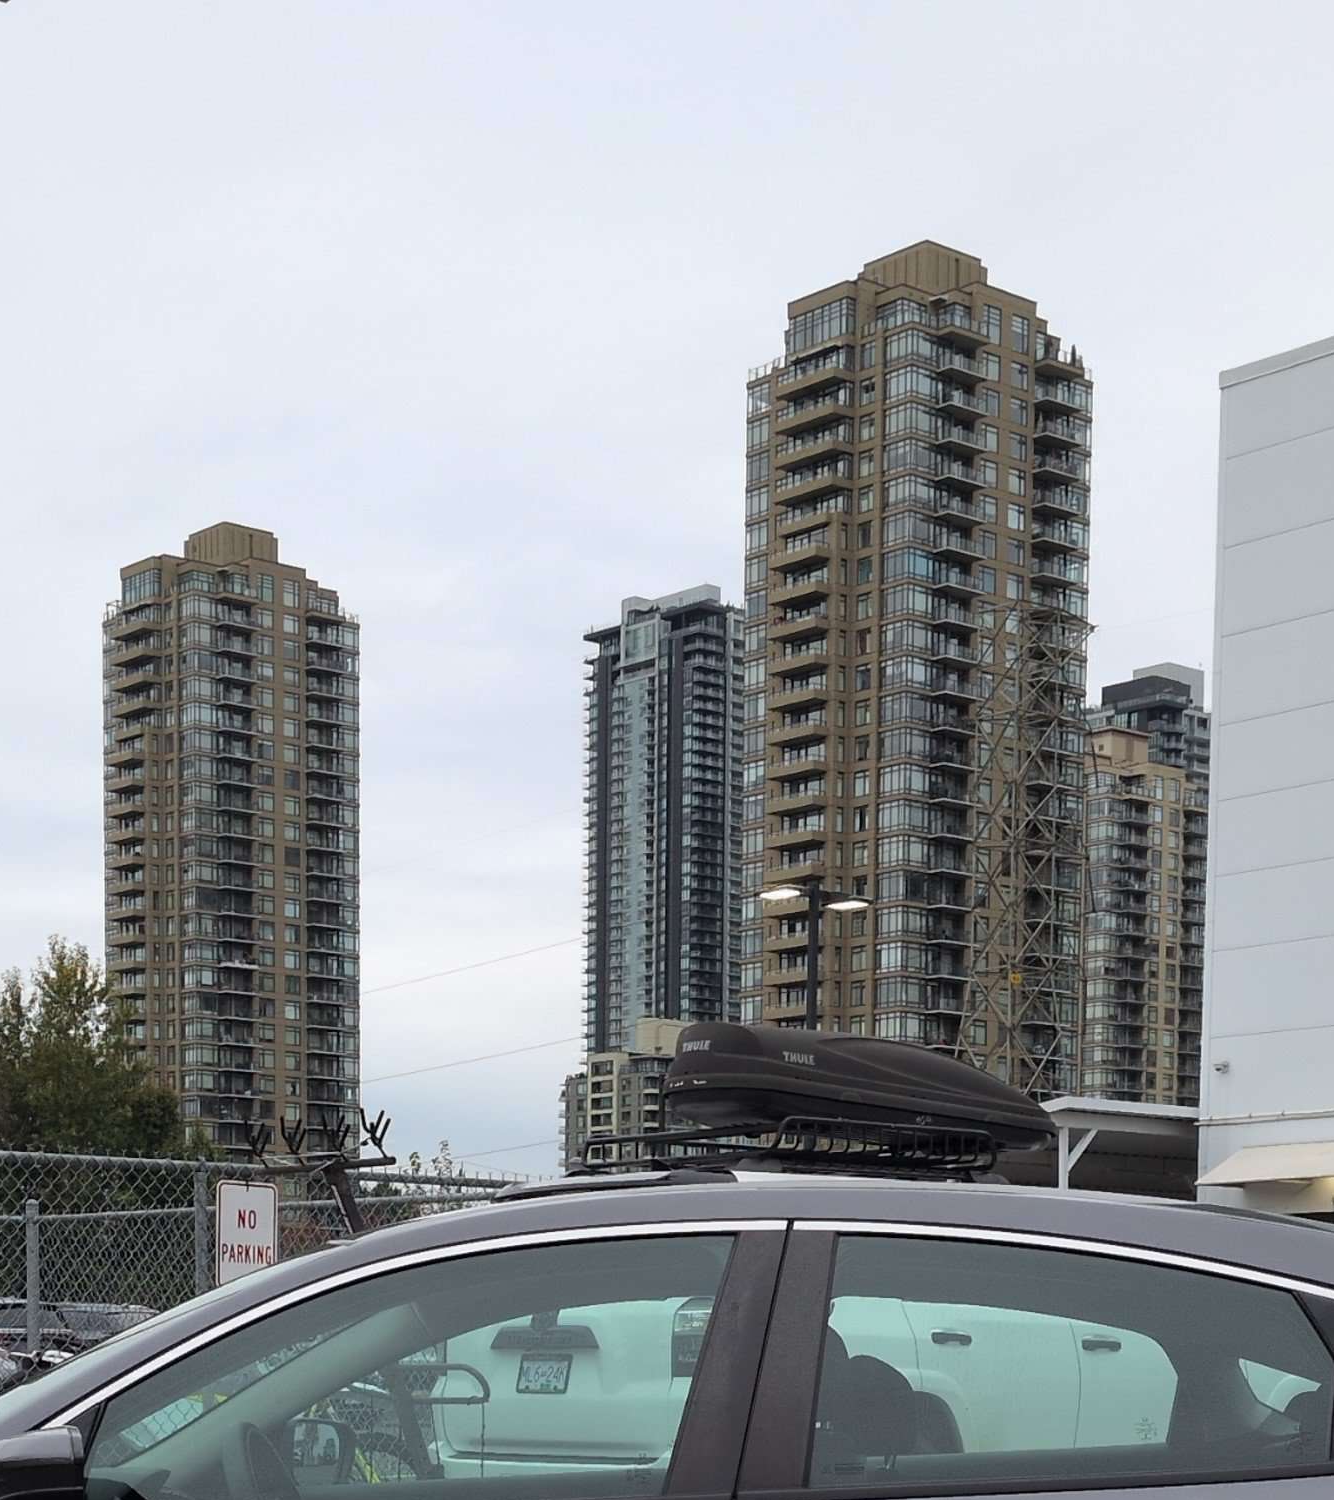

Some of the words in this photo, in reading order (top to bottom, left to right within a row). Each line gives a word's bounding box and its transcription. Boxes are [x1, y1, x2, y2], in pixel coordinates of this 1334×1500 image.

[782, 1051, 816, 1065] THULE
[237, 1209, 257, 1230] NO
[221, 1243, 272, 1265] PARKING
